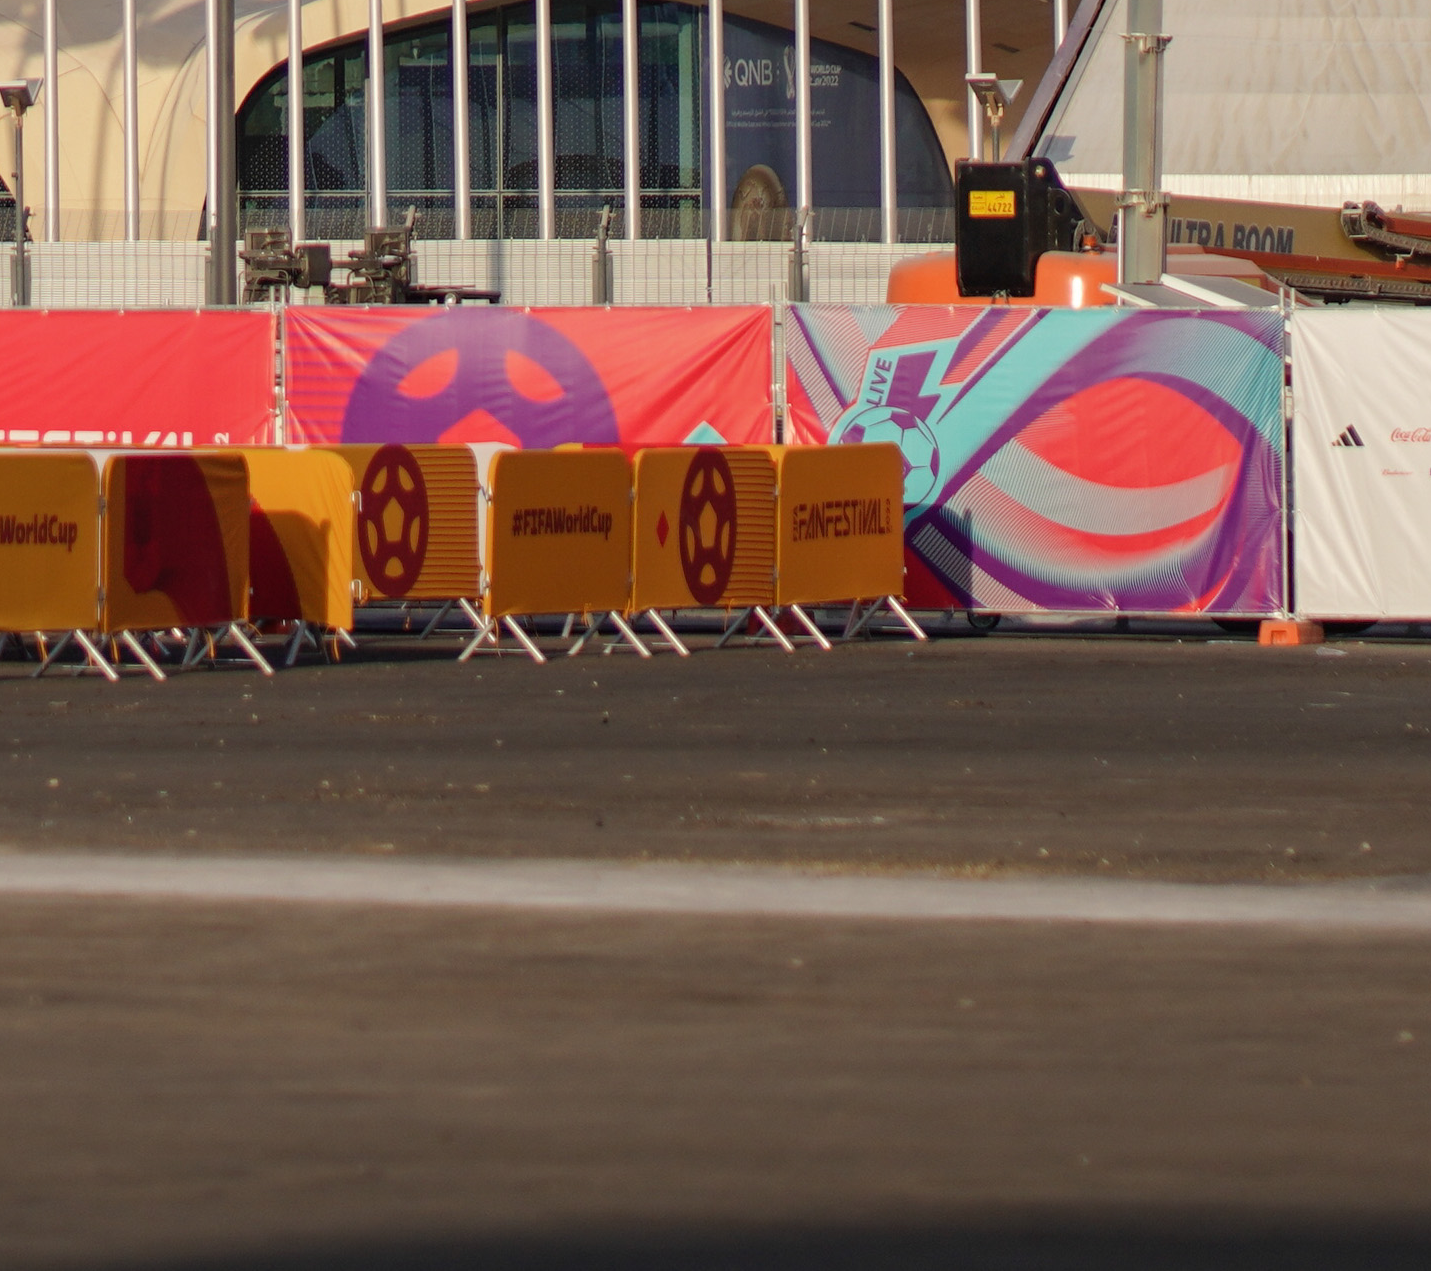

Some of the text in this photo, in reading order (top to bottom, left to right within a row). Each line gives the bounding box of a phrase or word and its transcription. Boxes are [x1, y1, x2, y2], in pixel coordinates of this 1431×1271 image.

[734, 58, 773, 87] QNB
[987, 202, 1013, 213] 44722
[1232, 223, 1292, 254] BOOM
[866, 356, 893, 408] LIVE
[511, 505, 613, 540] #FIFAWorldCup
